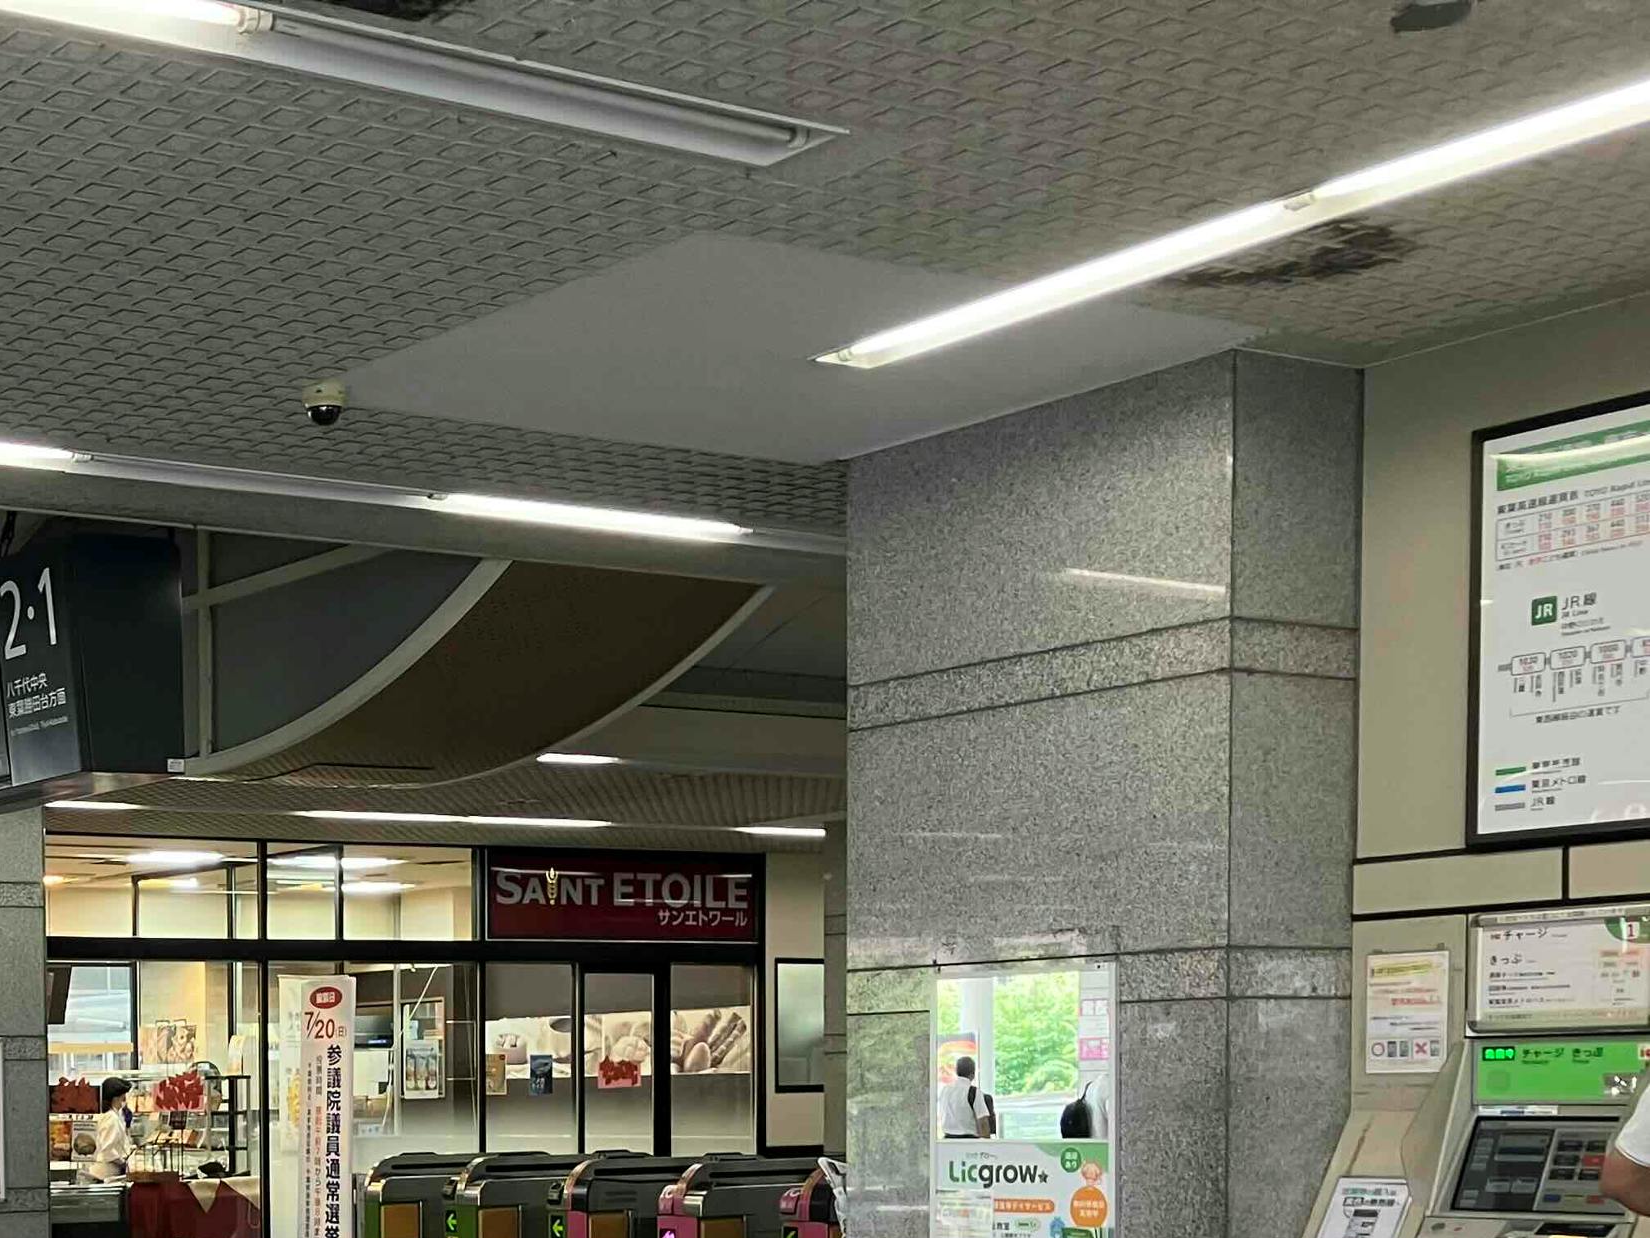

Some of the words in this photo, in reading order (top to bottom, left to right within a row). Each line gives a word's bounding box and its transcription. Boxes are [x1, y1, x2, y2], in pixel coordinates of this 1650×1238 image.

[1534, 602, 1553, 619] JR
[6, 672, 49, 698] 八千代中央
[612, 873, 749, 909] ETOILE
[657, 908, 748, 928] サンエトワール
[1626, 923, 1635, 938] 1
[1489, 953, 1523, 966] きっぷ
[948, 1160, 1038, 1189] Licgrow
